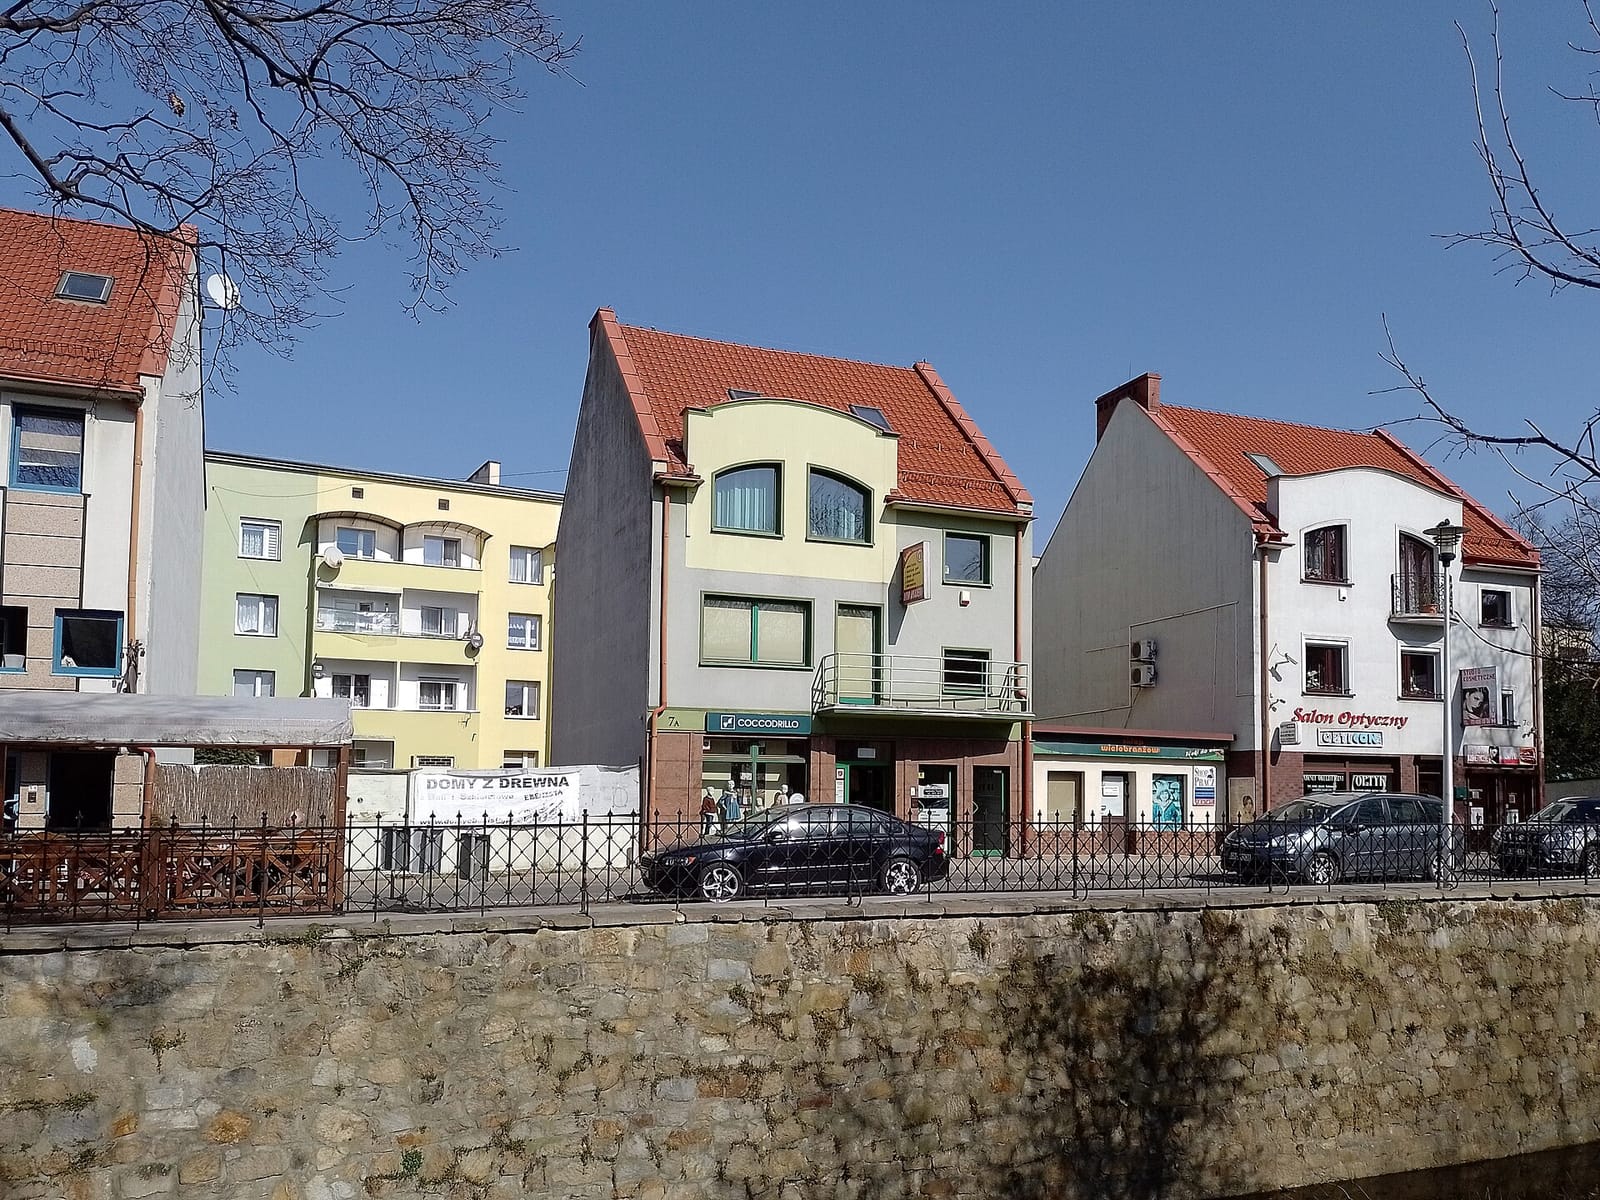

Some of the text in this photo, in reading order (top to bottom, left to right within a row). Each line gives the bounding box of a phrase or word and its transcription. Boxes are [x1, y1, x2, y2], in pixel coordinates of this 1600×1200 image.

[737, 718, 799, 729] COCCODRILLO
[1291, 707, 1409, 730] Salon Optyczny
[426, 776, 570, 790] DOMY Z DREWNA
